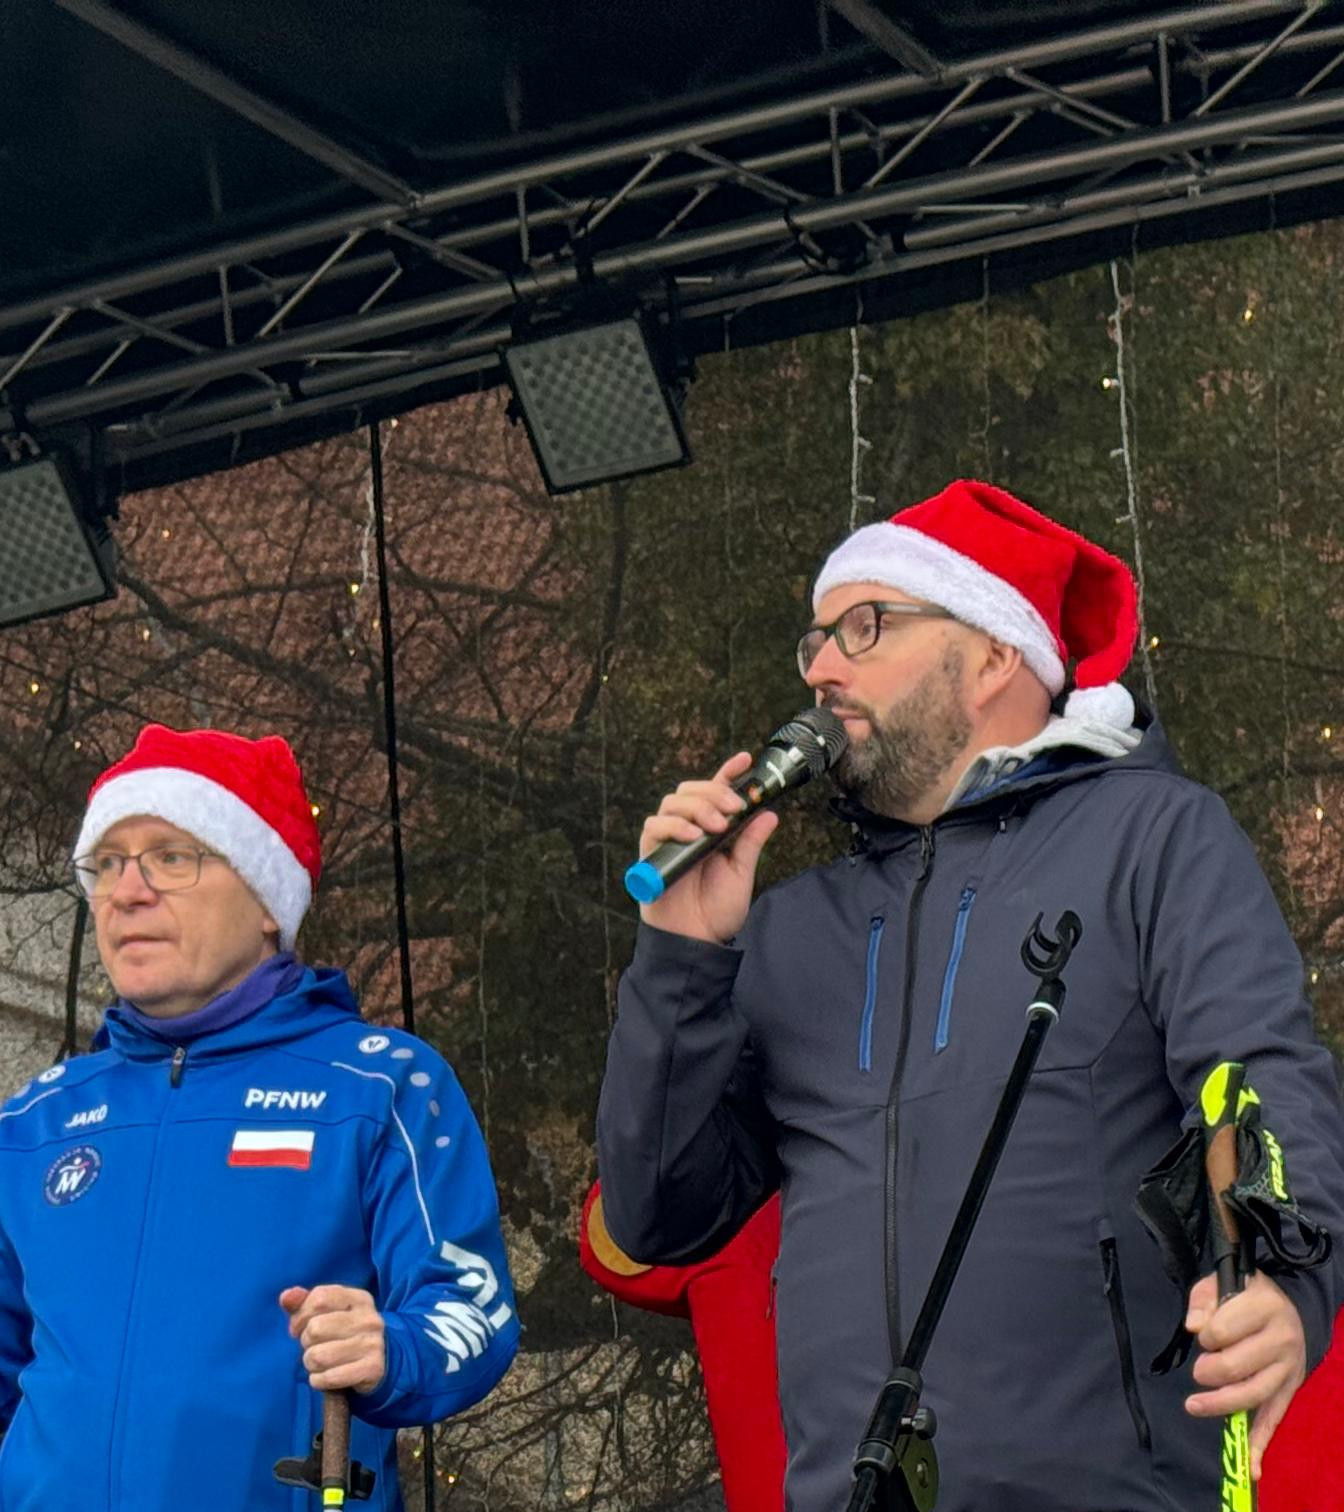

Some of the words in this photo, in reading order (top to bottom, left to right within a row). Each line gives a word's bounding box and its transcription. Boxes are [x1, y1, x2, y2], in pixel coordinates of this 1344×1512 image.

[244, 1088, 327, 1110] PFNW
[64, 1104, 108, 1128] JAKO
[1262, 1129, 1288, 1200] FIZAN
